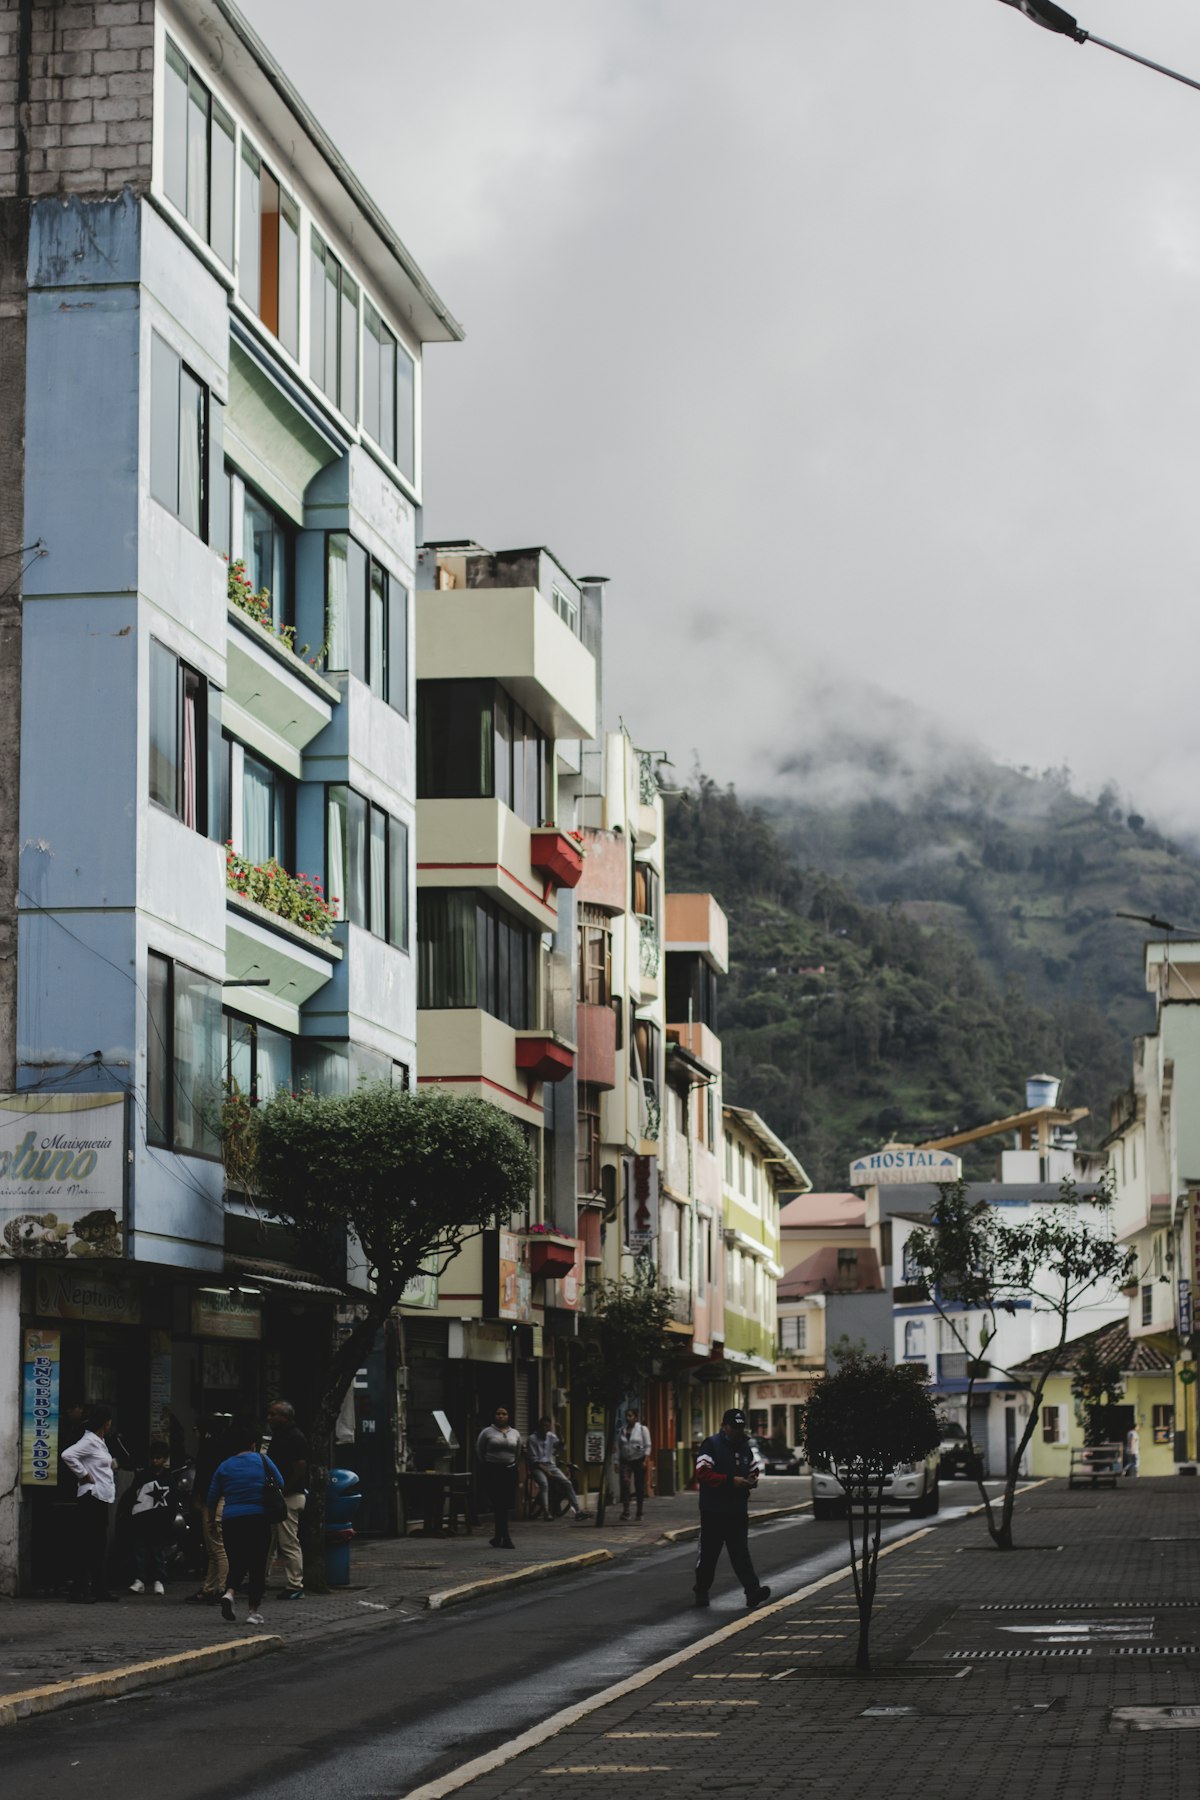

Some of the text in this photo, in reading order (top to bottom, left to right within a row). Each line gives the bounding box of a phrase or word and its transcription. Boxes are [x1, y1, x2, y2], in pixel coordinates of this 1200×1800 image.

[41, 1134, 112, 1153] Marisqueria
[870, 1152, 937, 1169] HOSTAL
[53, 1271, 126, 1315] Neptuno
[32, 1357, 51, 1480] ENCEBOLLADOS
